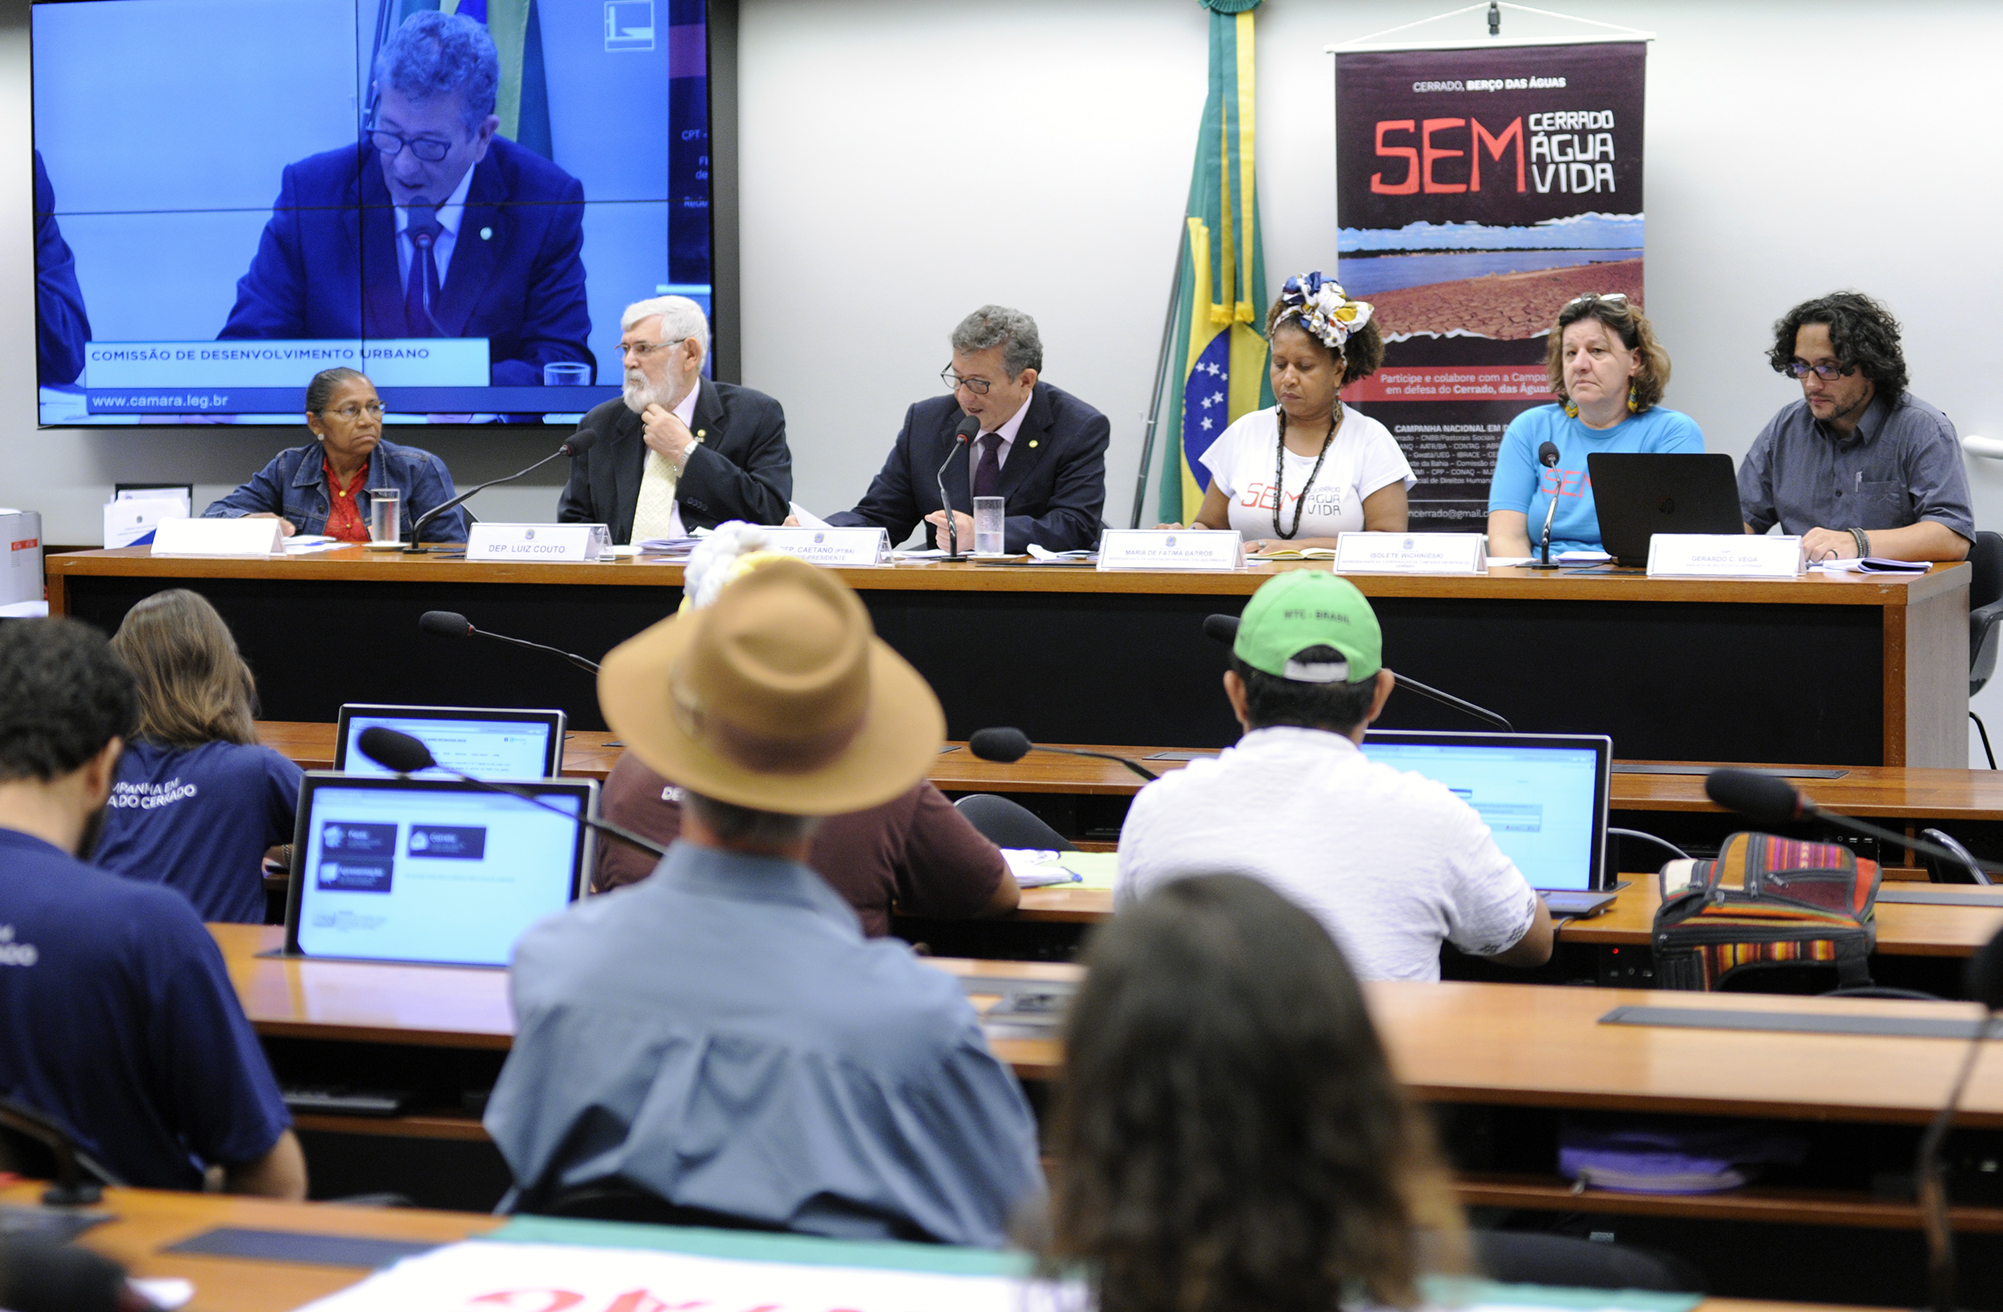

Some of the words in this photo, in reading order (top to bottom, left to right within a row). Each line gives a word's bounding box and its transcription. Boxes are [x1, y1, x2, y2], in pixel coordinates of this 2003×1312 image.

[1412, 81, 1465, 93] CERRADO,
[1466, 79, 1503, 93] BERÇO
[1505, 79, 1528, 90] DAS
[1529, 76, 1567, 89] ÁGUAS
[1529, 109, 1615, 131] CERRADO
[1530, 131, 1615, 163] ÁGUA
[1370, 115, 1526, 195] SEM
[1530, 162, 1616, 194] VIDA
[91, 348, 170, 361] COMISSÃO
[176, 350, 195, 360] DE
[201, 349, 353, 360] DESENVOLVIMENTO
[361, 349, 430, 359] URBANO
[1380, 373, 1422, 385] Participe
[1424, 375, 1432, 383] e
[1434, 373, 1475, 383] colabore
[1478, 374, 1500, 383] com
[1386, 386, 1402, 394] em
[1404, 385, 1437, 395] defesa
[1440, 385, 1452, 394] do
[1453, 384, 1498, 396] Cerrado,
[1499, 384, 1518, 394] das
[1520, 383, 1551, 396] Águas
[92, 393, 228, 409] www.camara.leg.br
[1394, 424, 1442, 433] CAMPANHA
[1443, 424, 1486, 433] NACIONAL
[1487, 424, 1501, 432] EM
[1241, 482, 1303, 514] SEM
[1308, 504, 1341, 516] VIDA
[1408, 509, 1489, 520] ncerrado@gmail.c
[488, 544, 508, 553] DEP.
[512, 545, 532, 553] LUIZ
[534, 545, 566, 554] COUTO
[797, 546, 834, 554] CAETANO
[119, 794, 140, 808] DO
[140, 783, 198, 810] CERRADO
